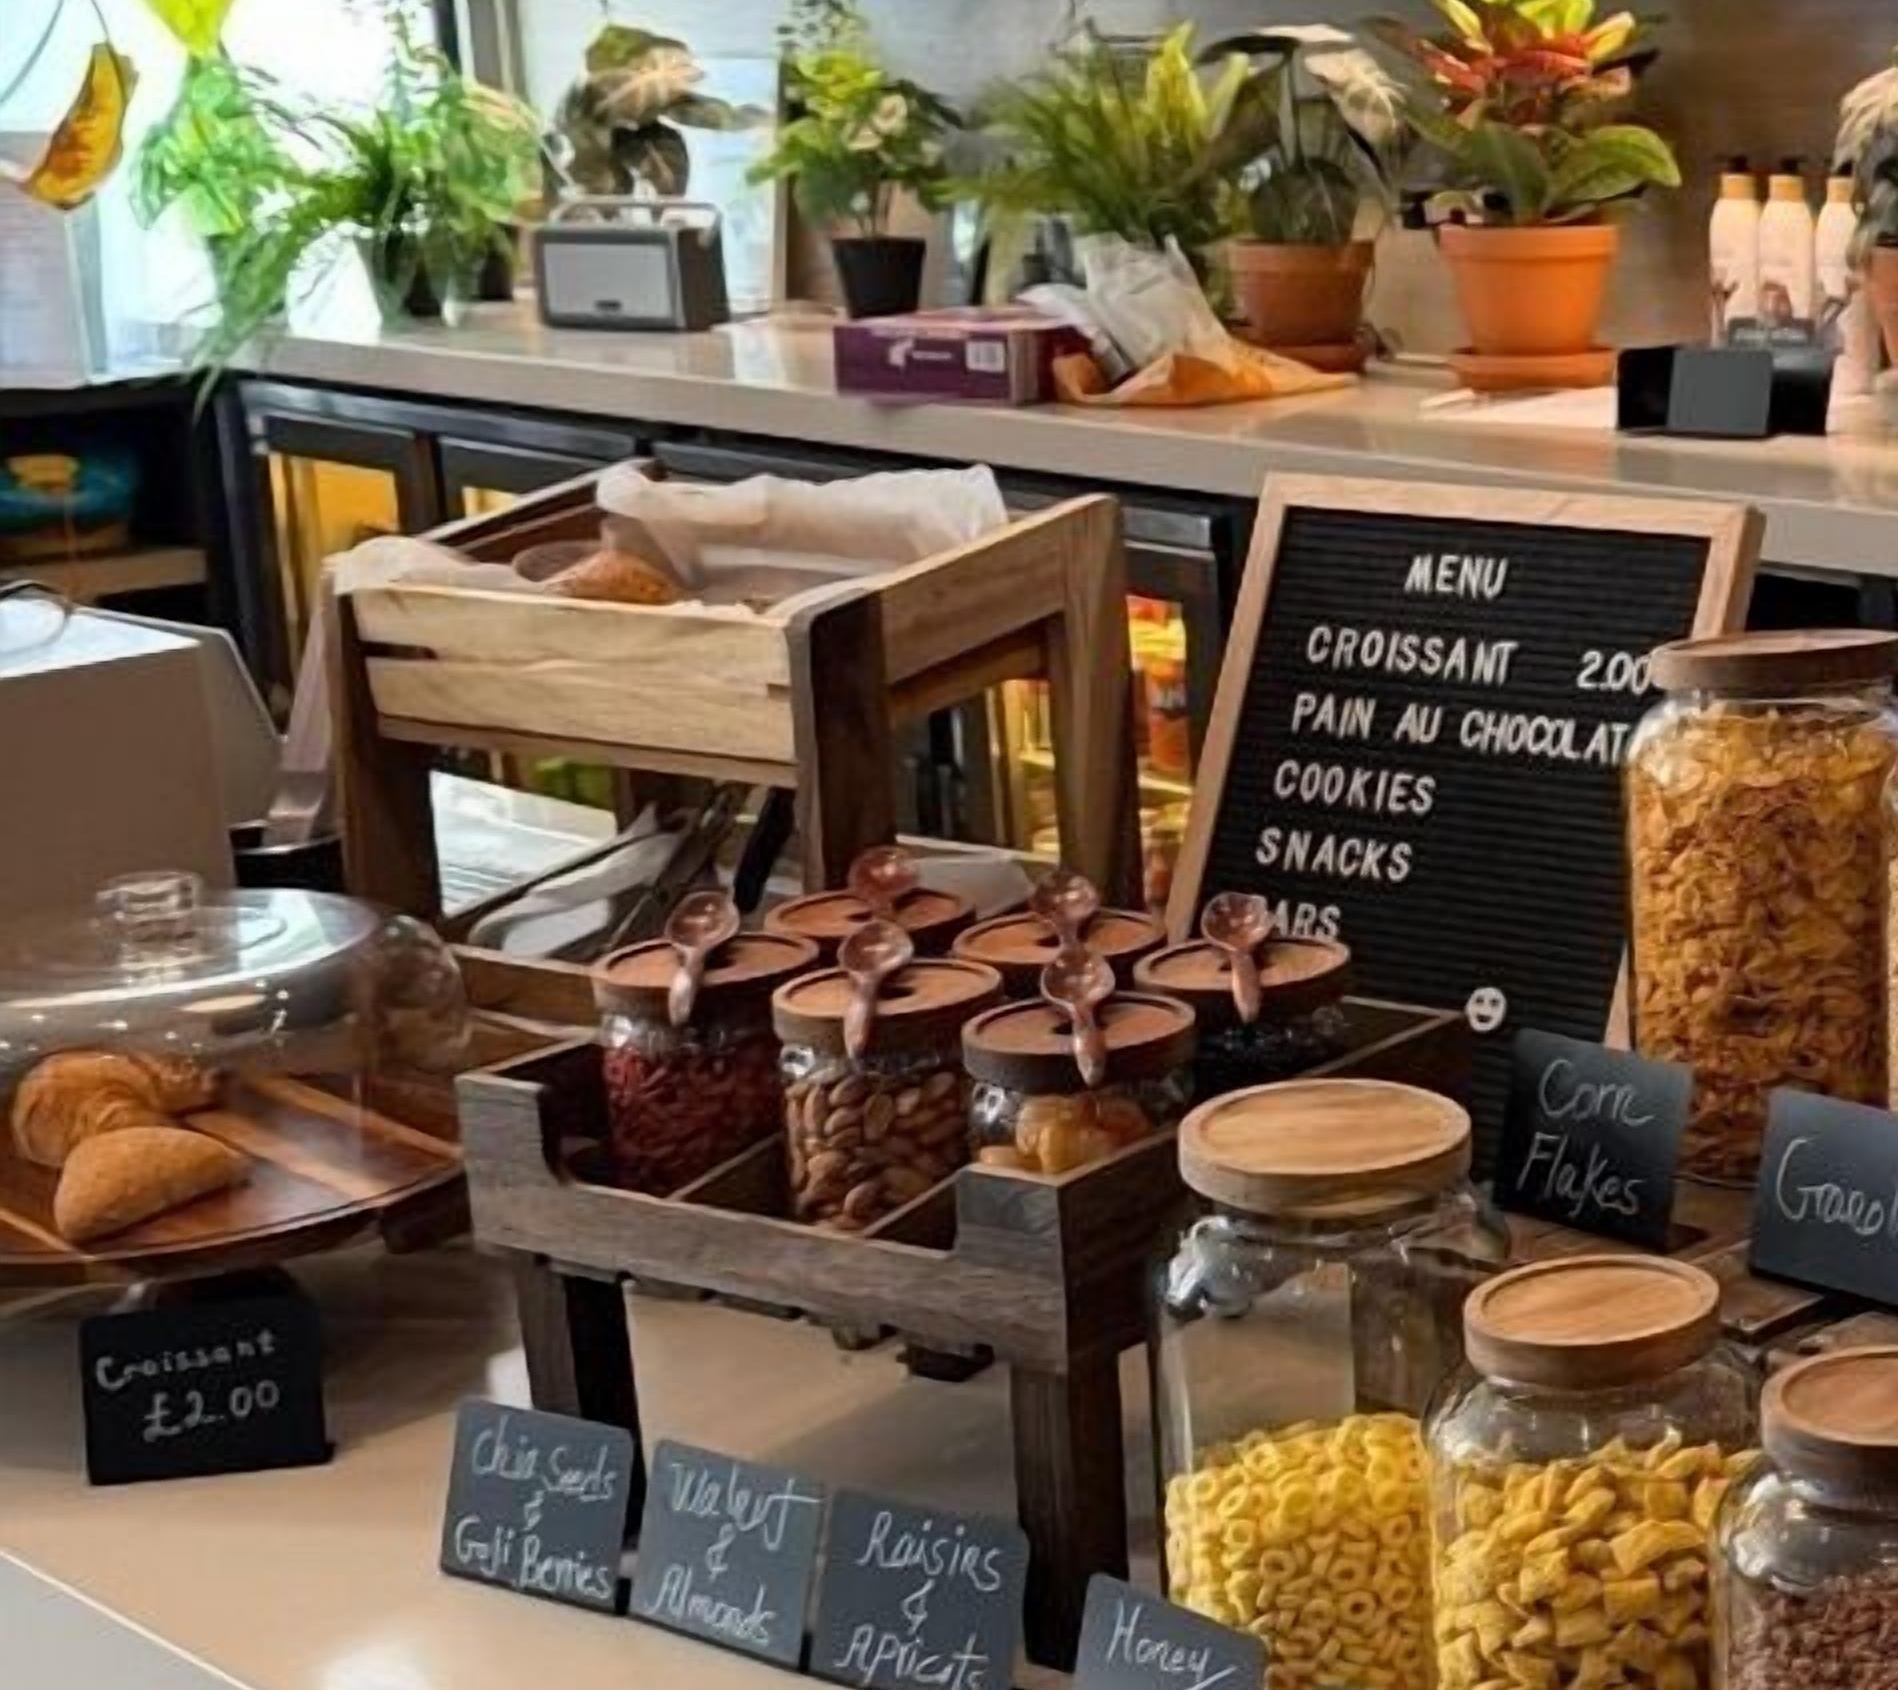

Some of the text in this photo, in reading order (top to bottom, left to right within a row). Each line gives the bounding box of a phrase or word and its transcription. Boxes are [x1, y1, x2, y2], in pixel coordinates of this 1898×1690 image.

[1404, 554, 1509, 599] MENU
[1307, 625, 1518, 685] CROISSANT
[1291, 692, 1630, 765] PAIN AU CHOCOLAT
[1273, 759, 1436, 813] COOKIES
[1255, 827, 1412, 881] SNACKS
[1272, 901, 1340, 938] ARS
[1538, 1059, 1655, 1126] Corn
[1517, 1131, 1647, 1217] Flakes
[143, 1380, 280, 1442] £2.00
[540, 1446, 618, 1502] Seeds
[456, 1515, 611, 1599] Goji Berries
[857, 1511, 1000, 1591] Raisins
[644, 1564, 776, 1646] Almonds
